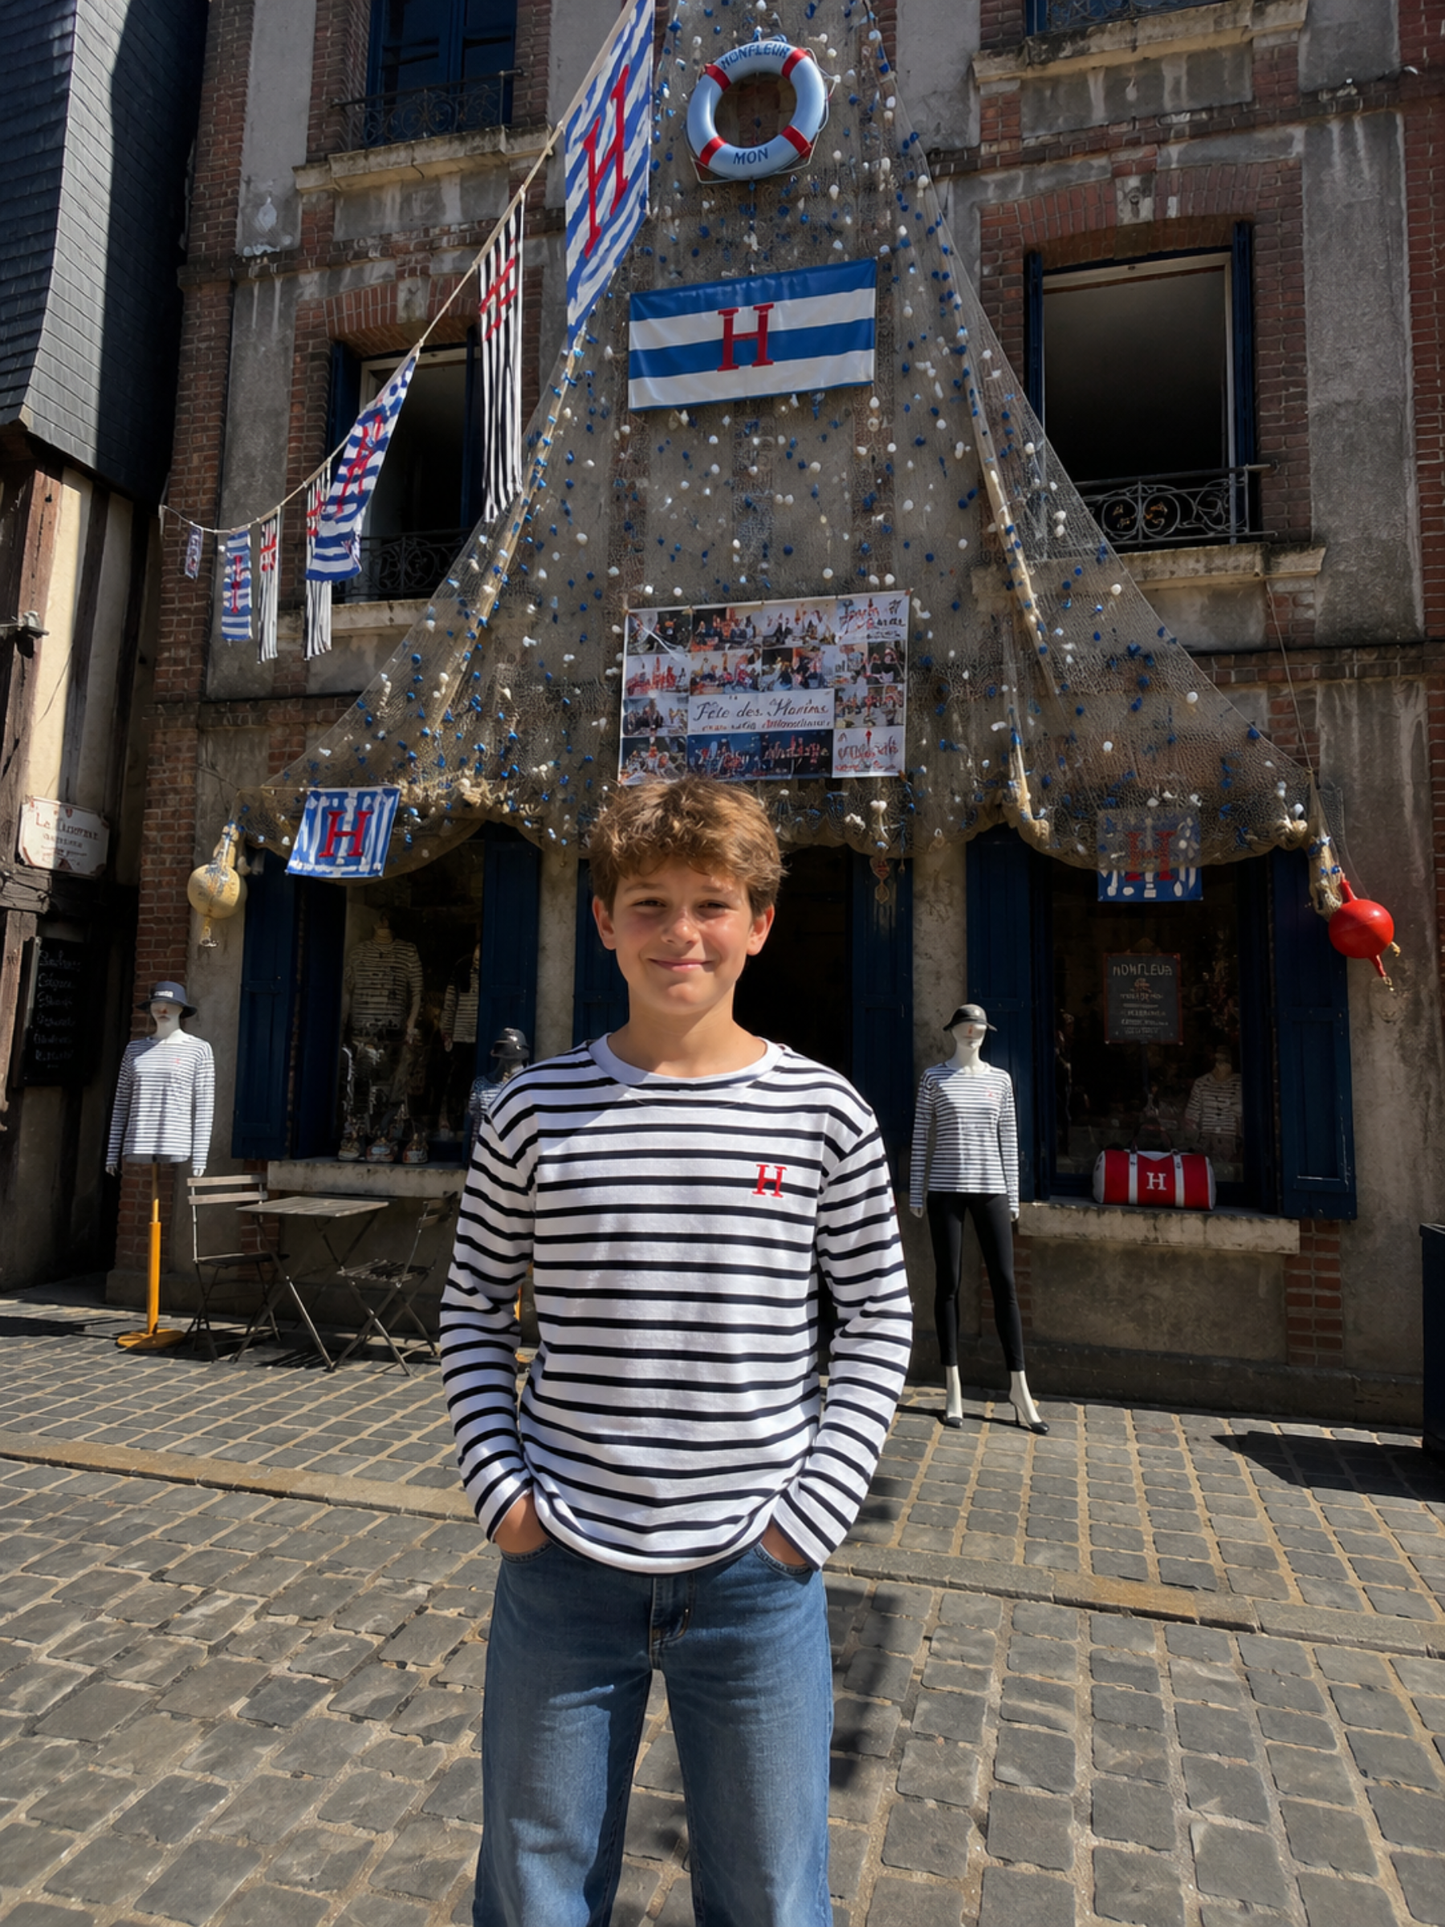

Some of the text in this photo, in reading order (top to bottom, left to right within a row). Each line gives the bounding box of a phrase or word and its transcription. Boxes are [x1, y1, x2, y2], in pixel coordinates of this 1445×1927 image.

[733, 148, 768, 165] MON
[717, 303, 774, 372] H
[318, 811, 373, 858] H
[1125, 830, 1177, 881] H
[752, 1164, 787, 1198] H
[1146, 1172, 1167, 1191] H
